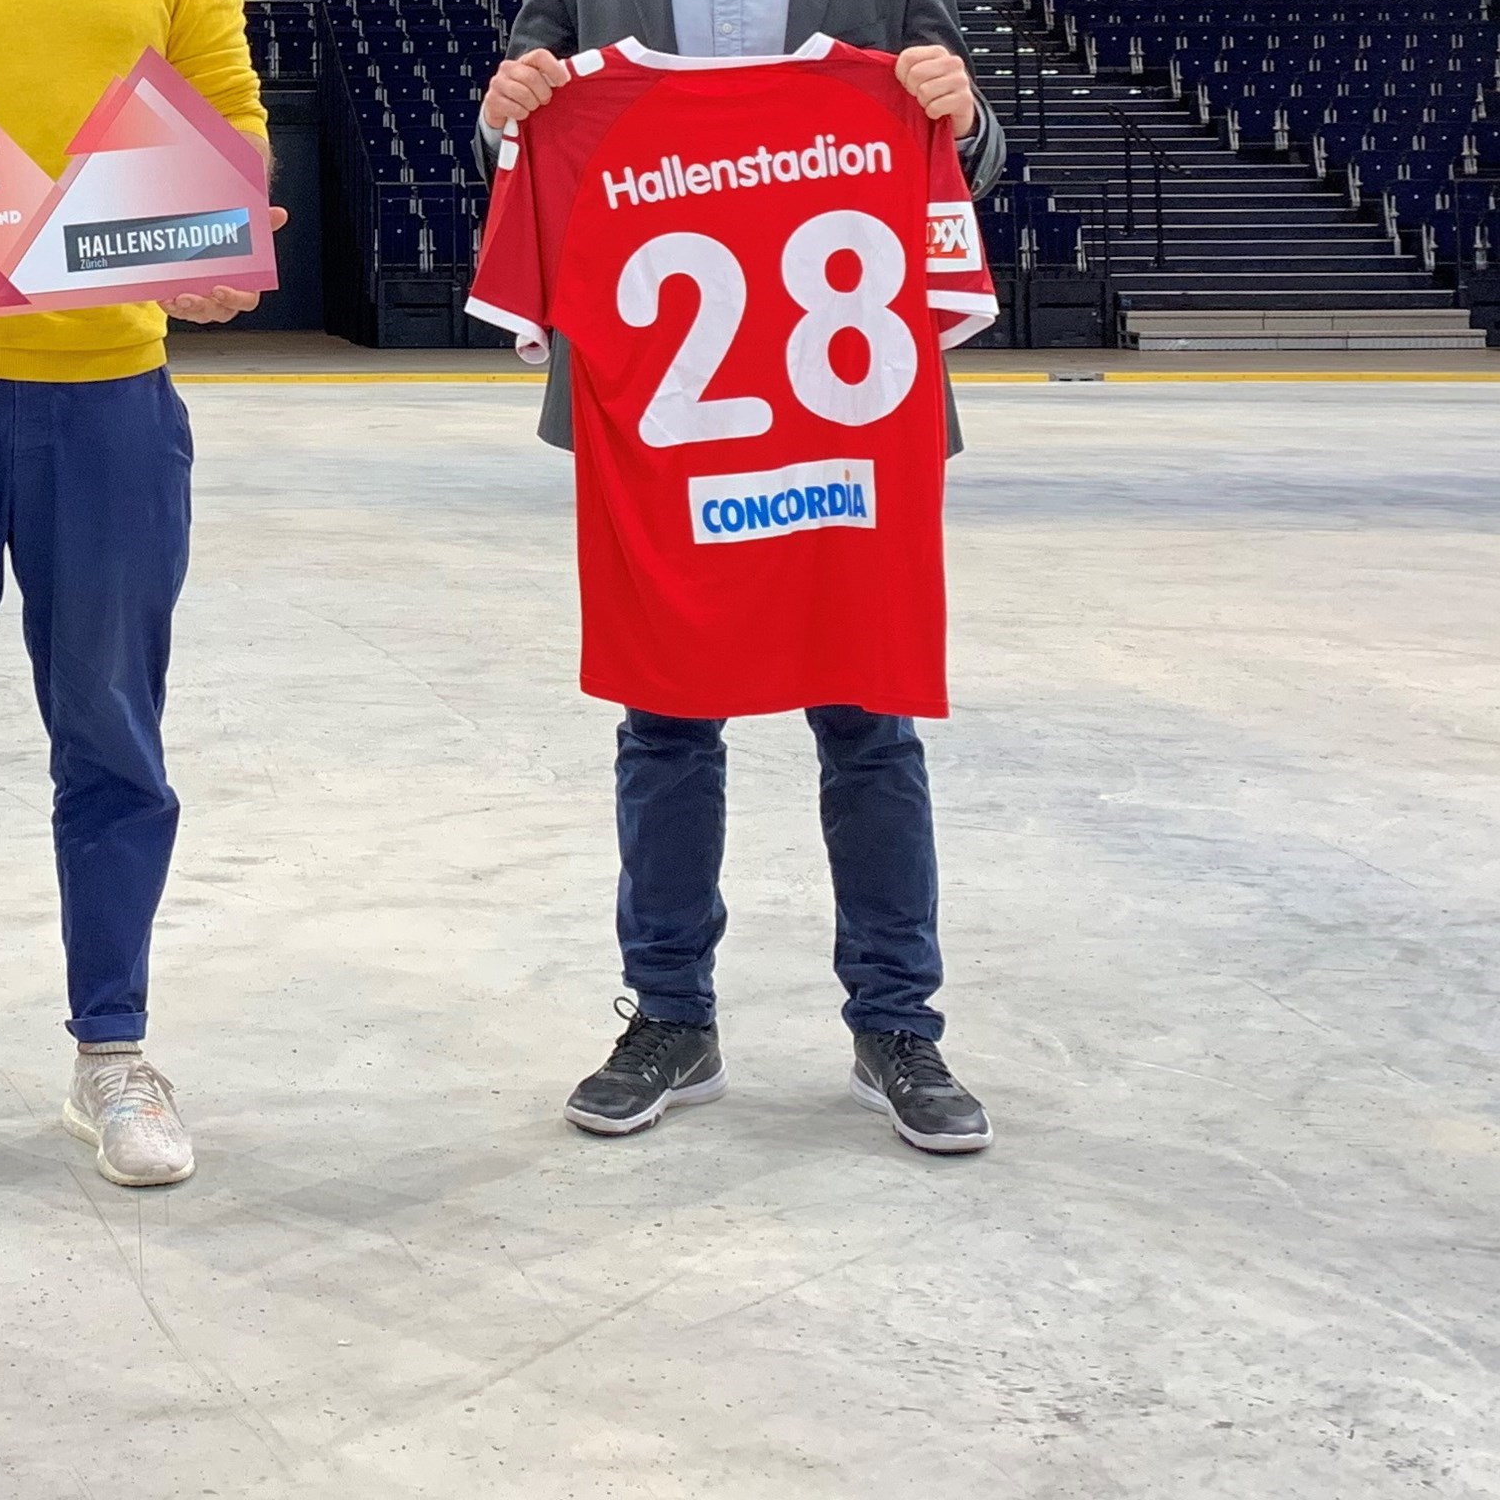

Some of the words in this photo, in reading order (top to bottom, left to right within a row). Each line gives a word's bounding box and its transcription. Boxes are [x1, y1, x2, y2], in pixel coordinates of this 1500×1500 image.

[602, 133, 892, 211] Hallenstadion
[77, 222, 239, 259] HALLENSTADION
[80, 257, 108, 270] Zürich
[616, 209, 918, 449] 28
[702, 470, 867, 535] CONCORDIA
